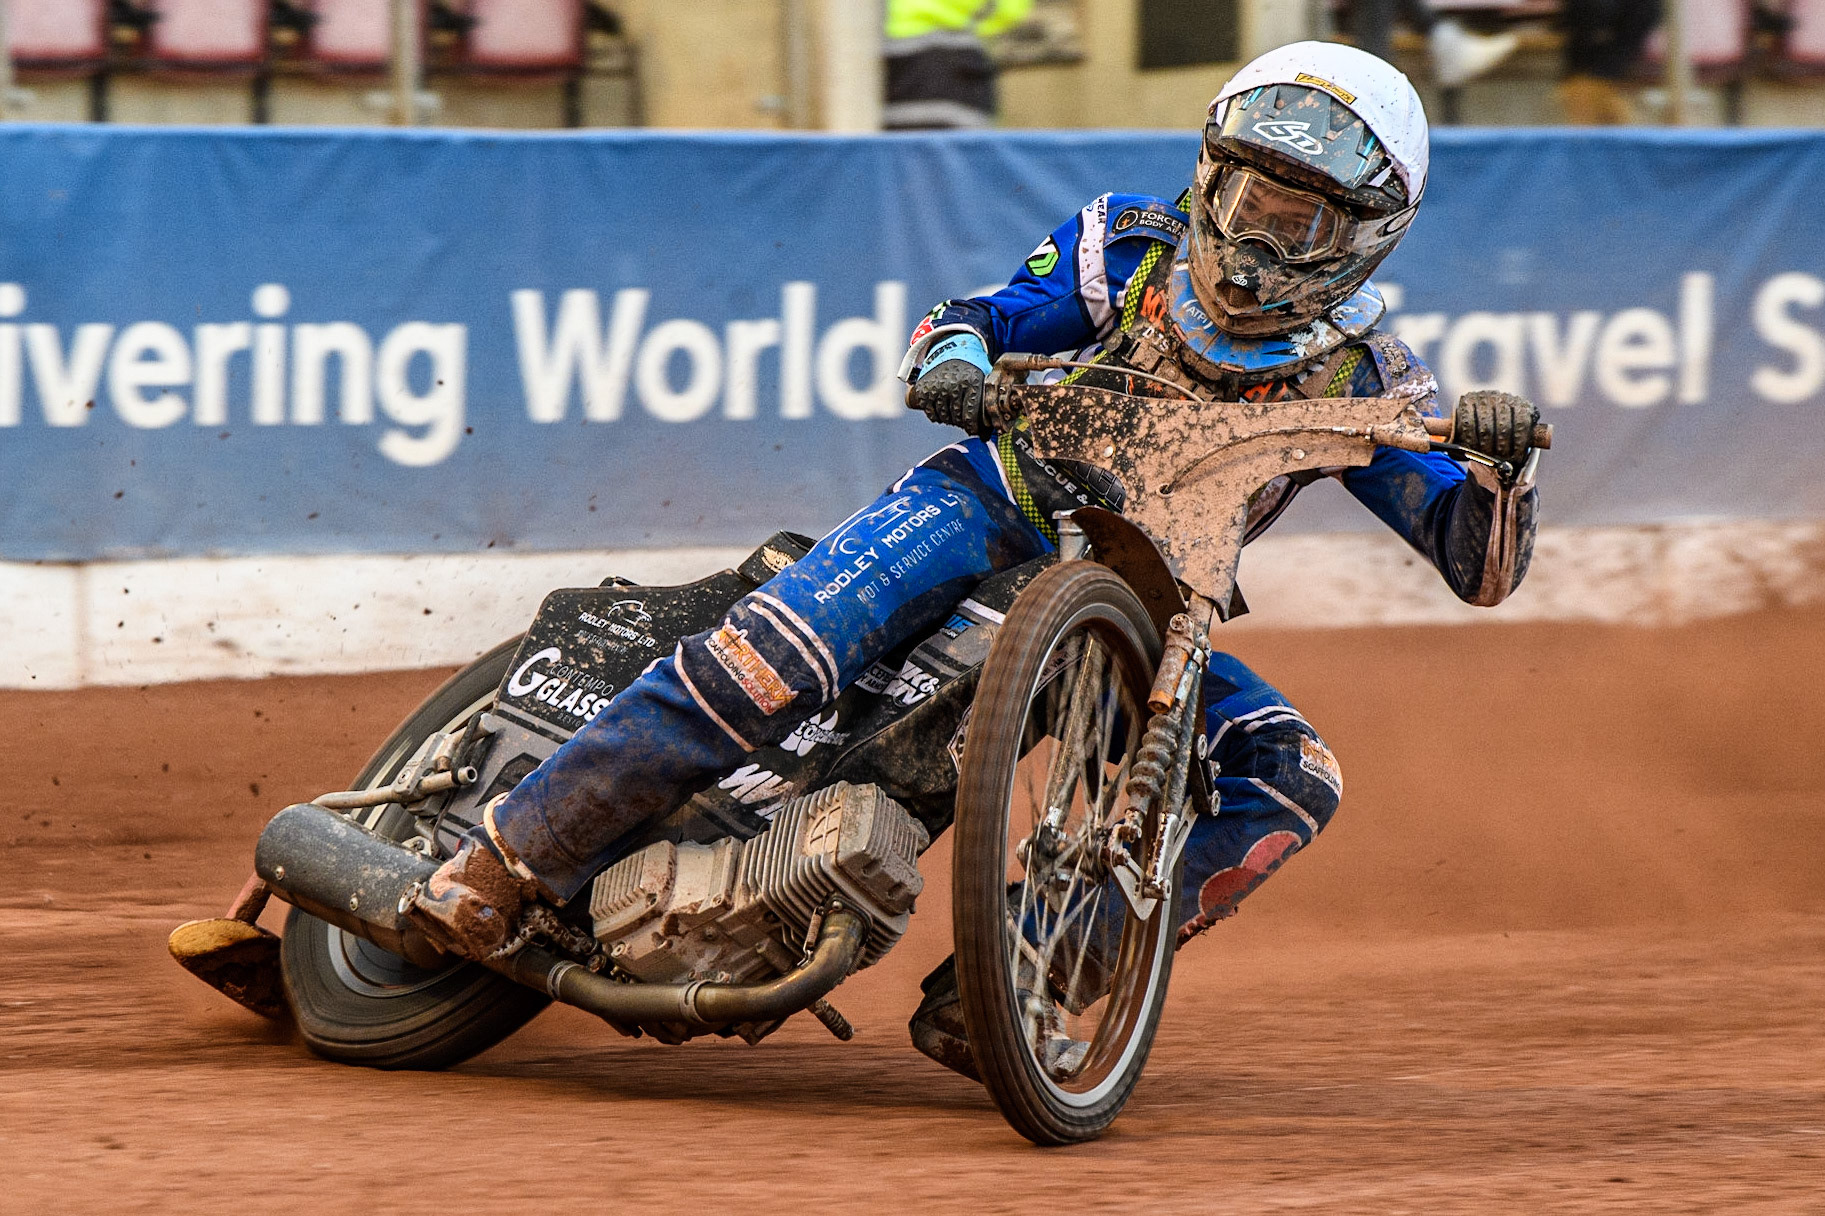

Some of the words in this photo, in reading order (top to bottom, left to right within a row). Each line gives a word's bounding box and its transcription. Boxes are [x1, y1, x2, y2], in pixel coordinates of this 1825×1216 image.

[1139, 219, 1164, 229] BODY
[509, 278, 908, 424] World
[1378, 270, 1715, 408] ravel
[1752, 271, 1825, 406] S
[1015, 437, 1077, 494] RESCUE
[813, 546, 880, 604] RODLEY
[881, 503, 942, 549] MOTORS
[939, 493, 967, 508] LT
[856, 580, 881, 604] MOT
[879, 572, 891, 587] &
[889, 540, 933, 580] SERVICE
[930, 518, 966, 547] CENTRE
[578, 611, 609, 629] RODLEY
[608, 622, 640, 641] MOTORS
[637, 634, 656, 648] LTD
[536, 677, 611, 722] GLASS
[549, 663, 614, 697] CONTEMPO
[557, 711, 588, 729] DESIG
